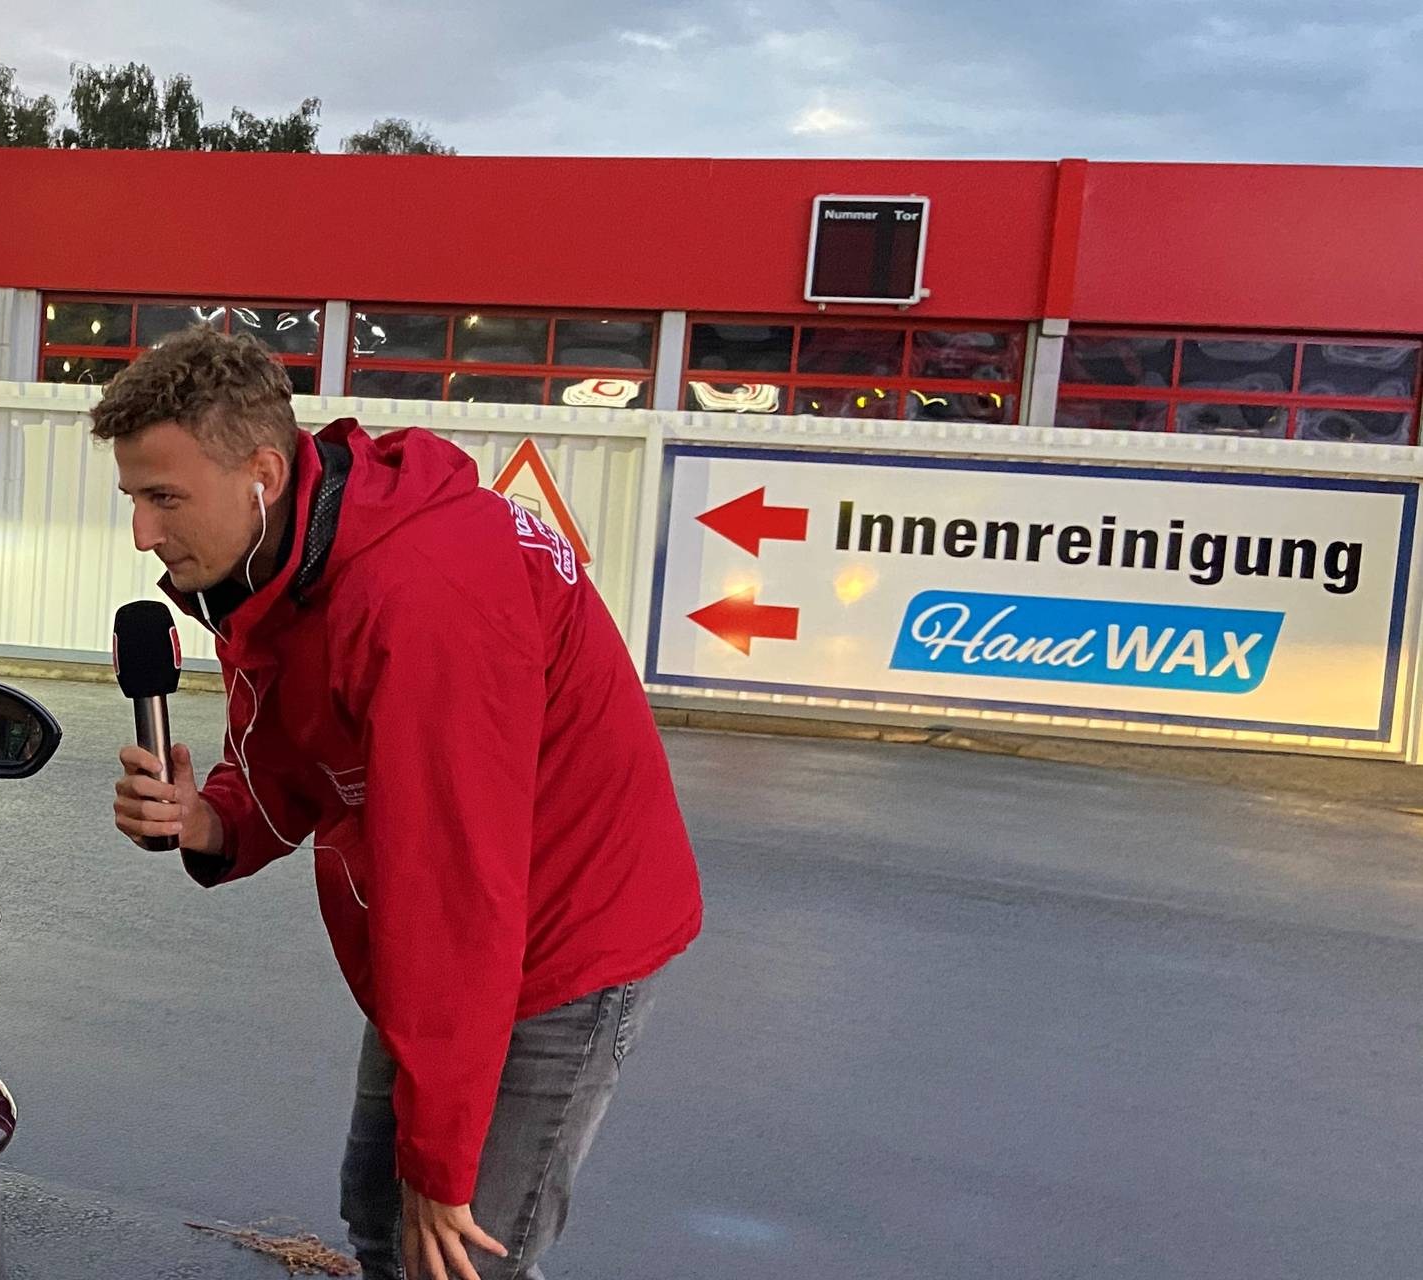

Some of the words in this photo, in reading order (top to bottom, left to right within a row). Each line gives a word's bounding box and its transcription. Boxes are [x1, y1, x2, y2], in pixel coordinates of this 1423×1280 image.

[824, 209, 878, 220] Nummer
[894, 210, 919, 220] Tor
[835, 500, 1363, 595] Innenreinigung
[910, 601, 1097, 668] Hand
[1106, 623, 1263, 680] WAX
